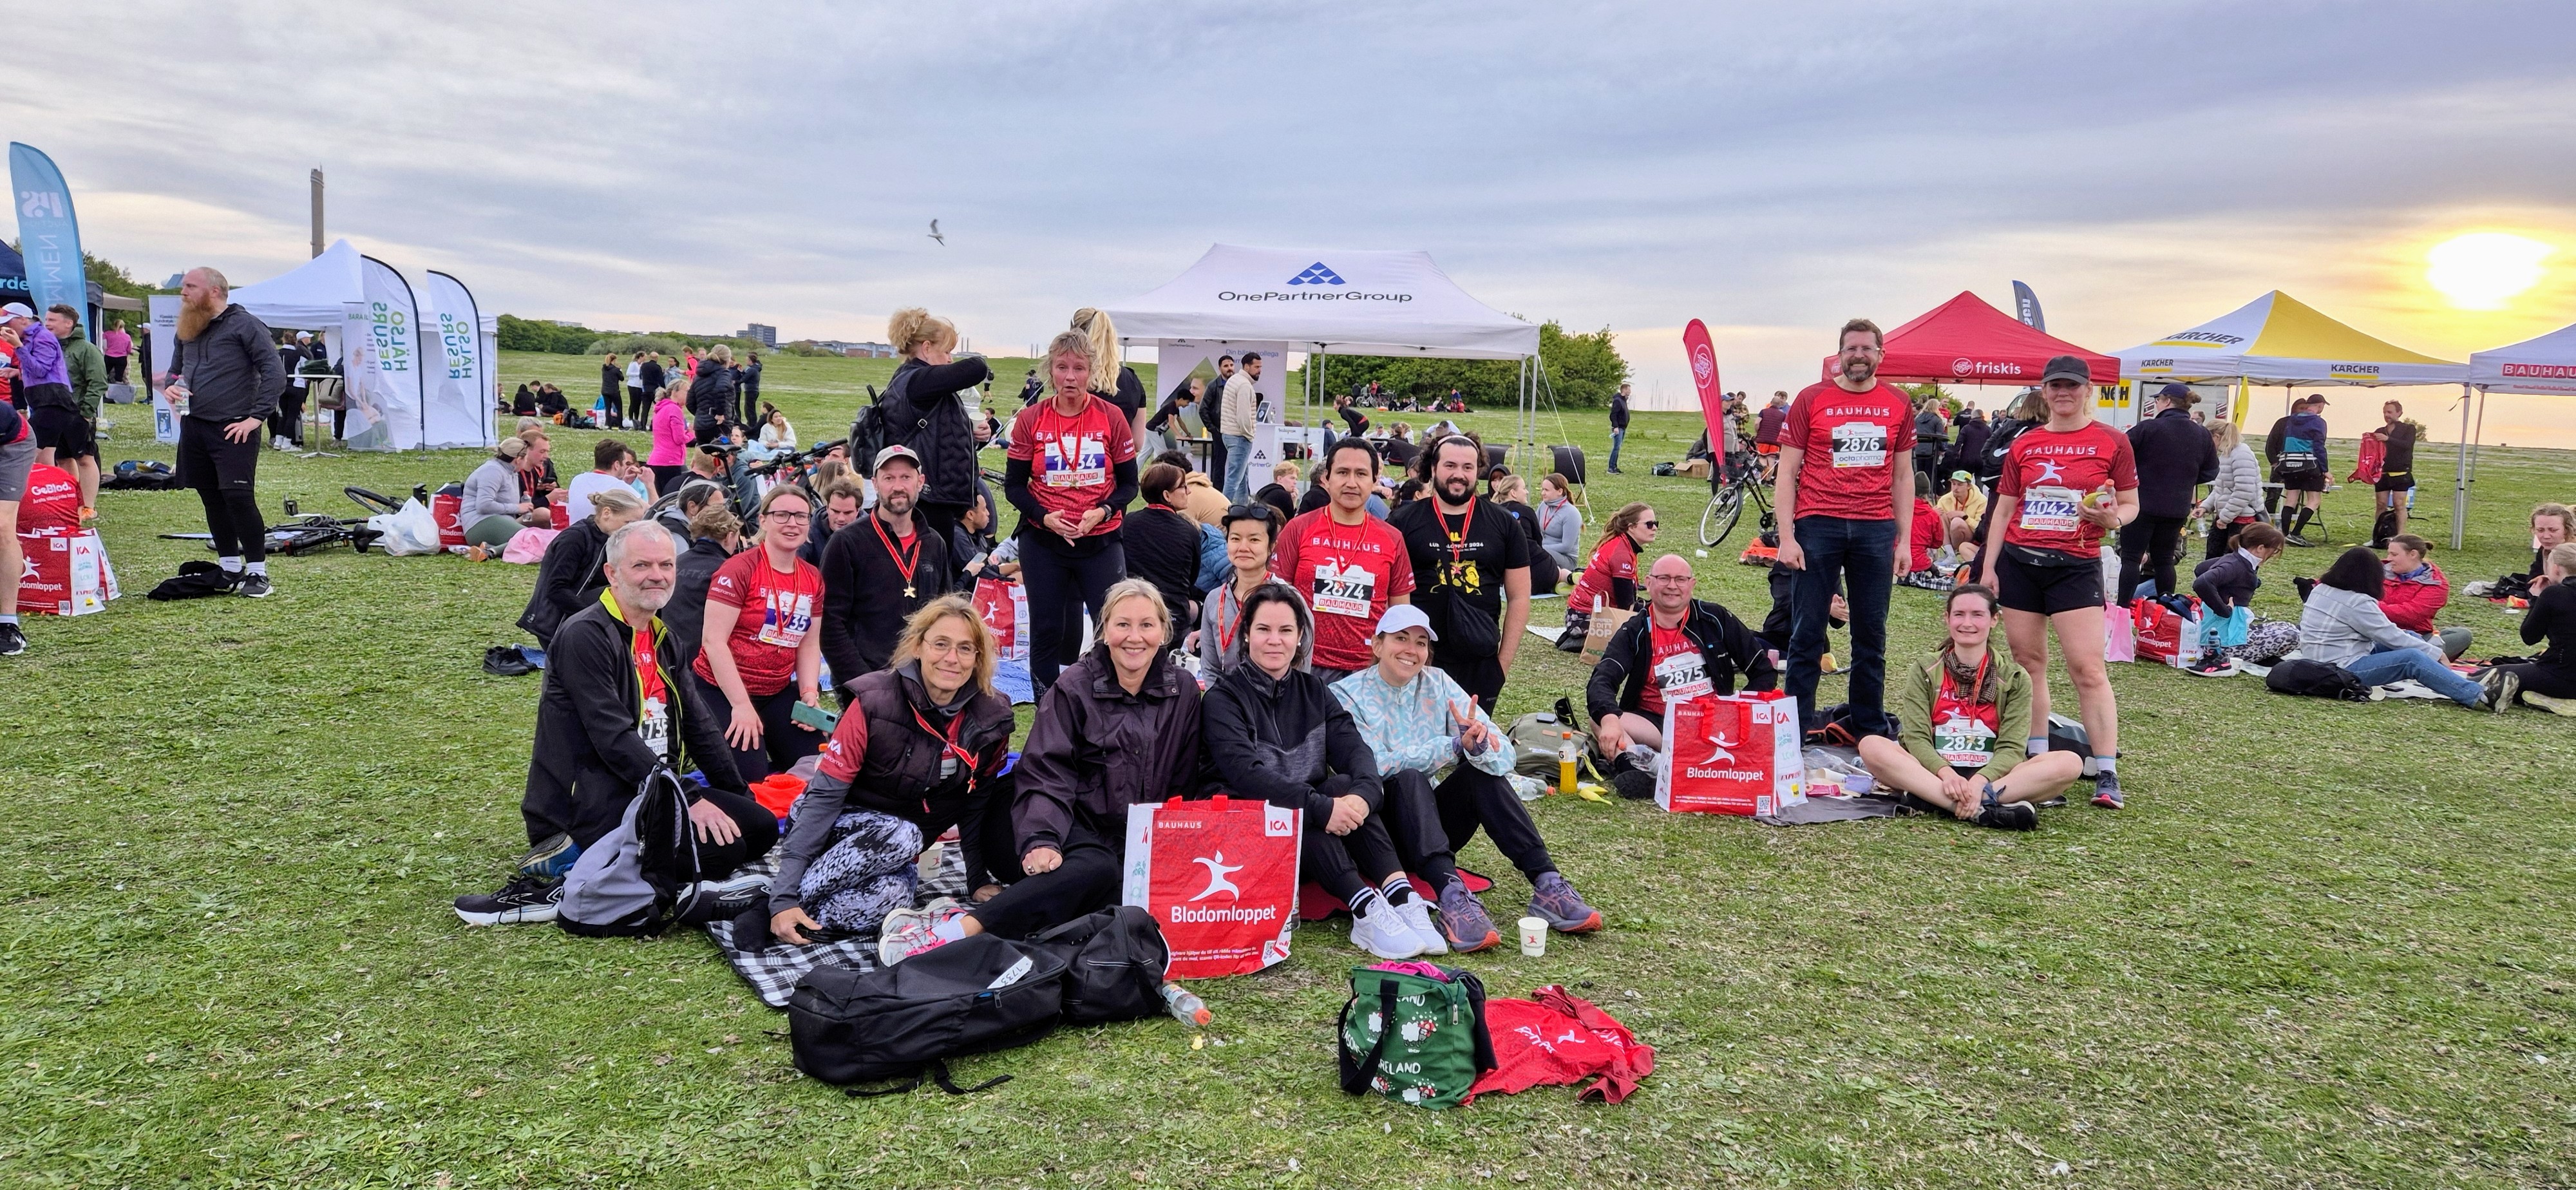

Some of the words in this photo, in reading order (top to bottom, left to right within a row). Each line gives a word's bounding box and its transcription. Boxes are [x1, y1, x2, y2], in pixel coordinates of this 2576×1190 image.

[1218, 291, 1413, 303] OnePartnerGroup
[1975, 362, 2022, 374] friskis
[2330, 364, 2380, 374] KÄRCHER
[2504, 364, 2576, 377] BAUHAU
[1826, 406, 1890, 417] BAUHAUS
[1840, 437, 1880, 452] 2876
[1053, 472, 1098, 482] BAUHAUS
[31, 481, 72, 495] GeBlod.
[2025, 501, 2078, 516] 40423
[2027, 518, 2074, 527] BAUHAUS
[76, 546, 90, 555] ICA
[717, 576, 732, 589] ICA
[1321, 580, 1365, 600] 2874
[1319, 599, 1363, 612] BAUHAUS
[1665, 666, 1705, 688] 2875
[1558, 750, 1564, 759] G
[1686, 766, 1764, 782] Blodomloppet
[1159, 820, 1202, 829] BAUHAUS
[1270, 820, 1288, 831] ICA
[1171, 905, 1276, 925] Blodomloppet
[1001, 967, 1023, 986] 1733
[1378, 1058, 1421, 1075] RELAND
